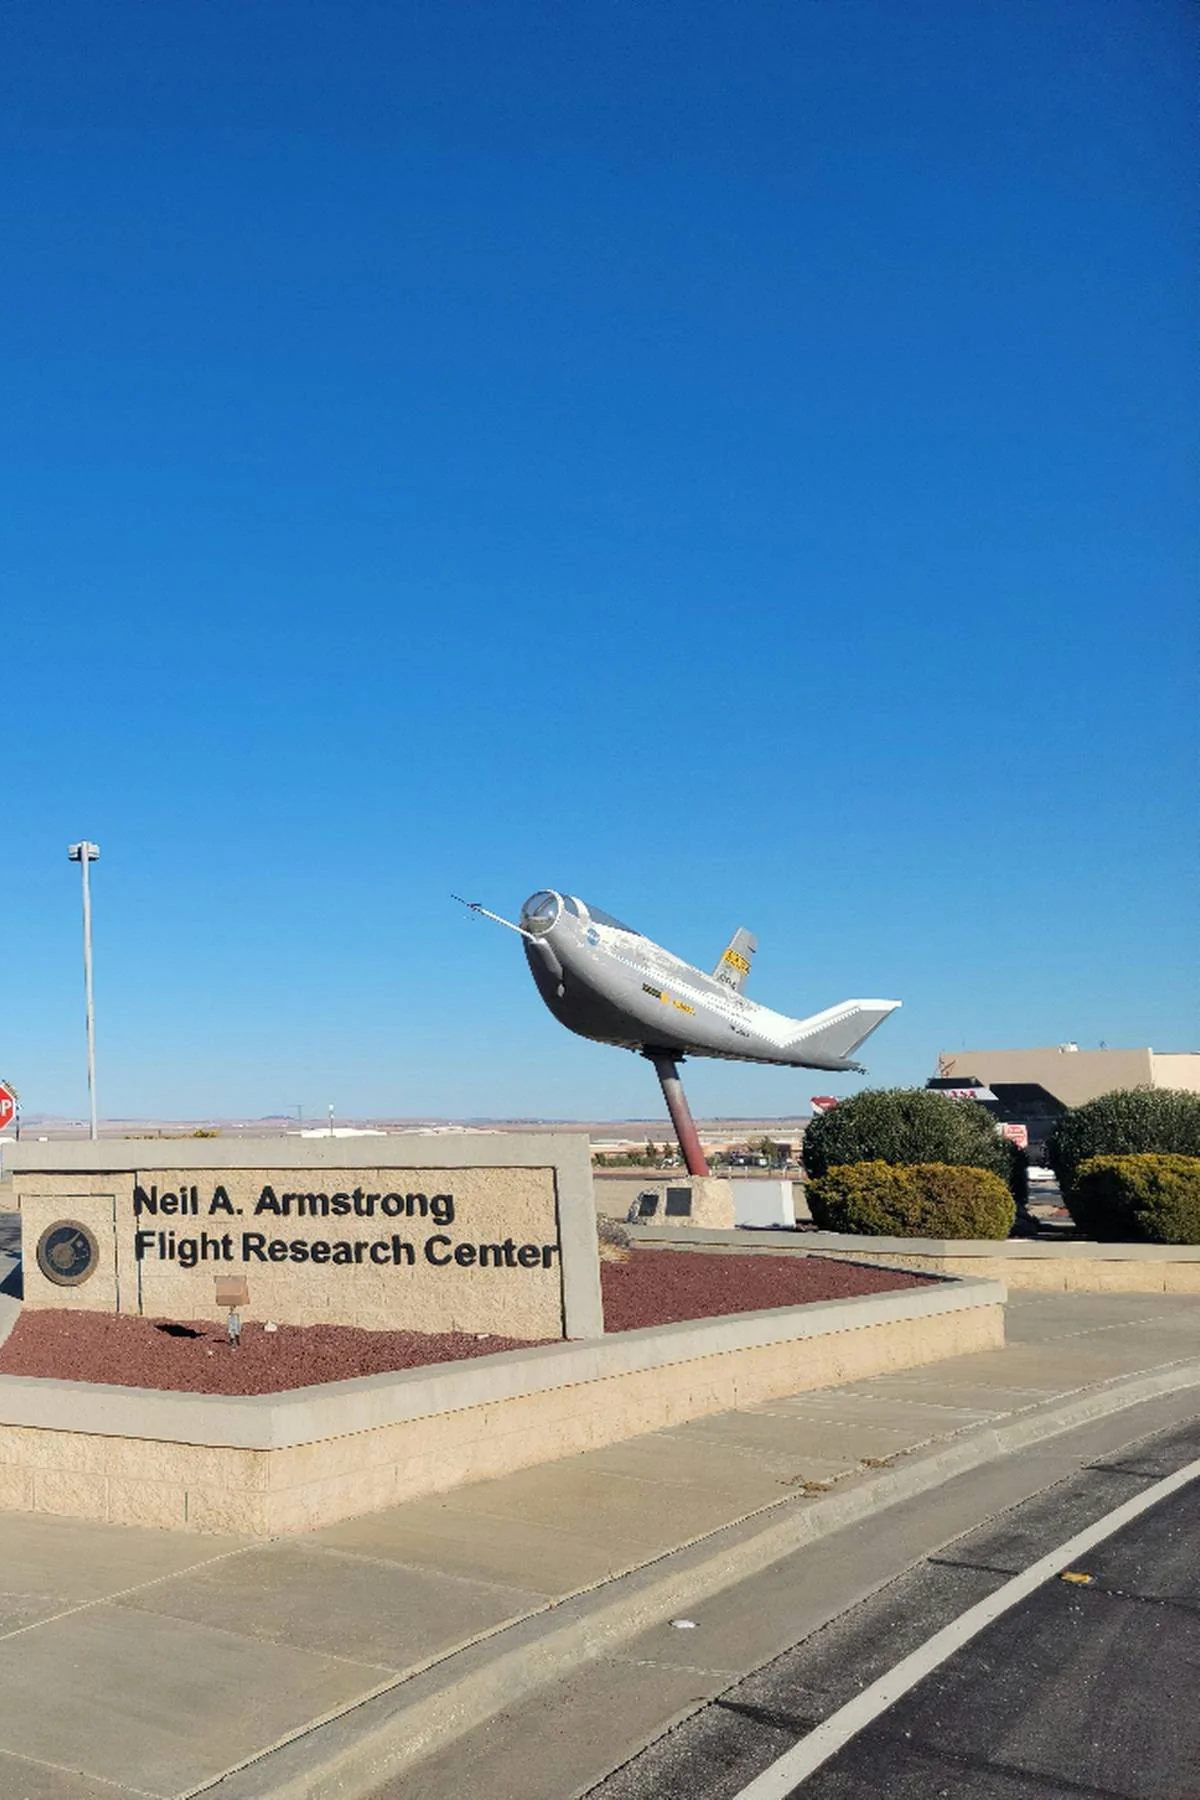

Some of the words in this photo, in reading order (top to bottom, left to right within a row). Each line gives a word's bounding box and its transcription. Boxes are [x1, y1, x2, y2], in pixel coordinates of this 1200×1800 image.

[133, 1185, 198, 1217] Neil
[208, 1187, 243, 1216] A.
[254, 1187, 455, 1225] Armstrong
[135, 1231, 234, 1268] Flight
[242, 1233, 415, 1265] Research
[424, 1234, 559, 1269] Center
